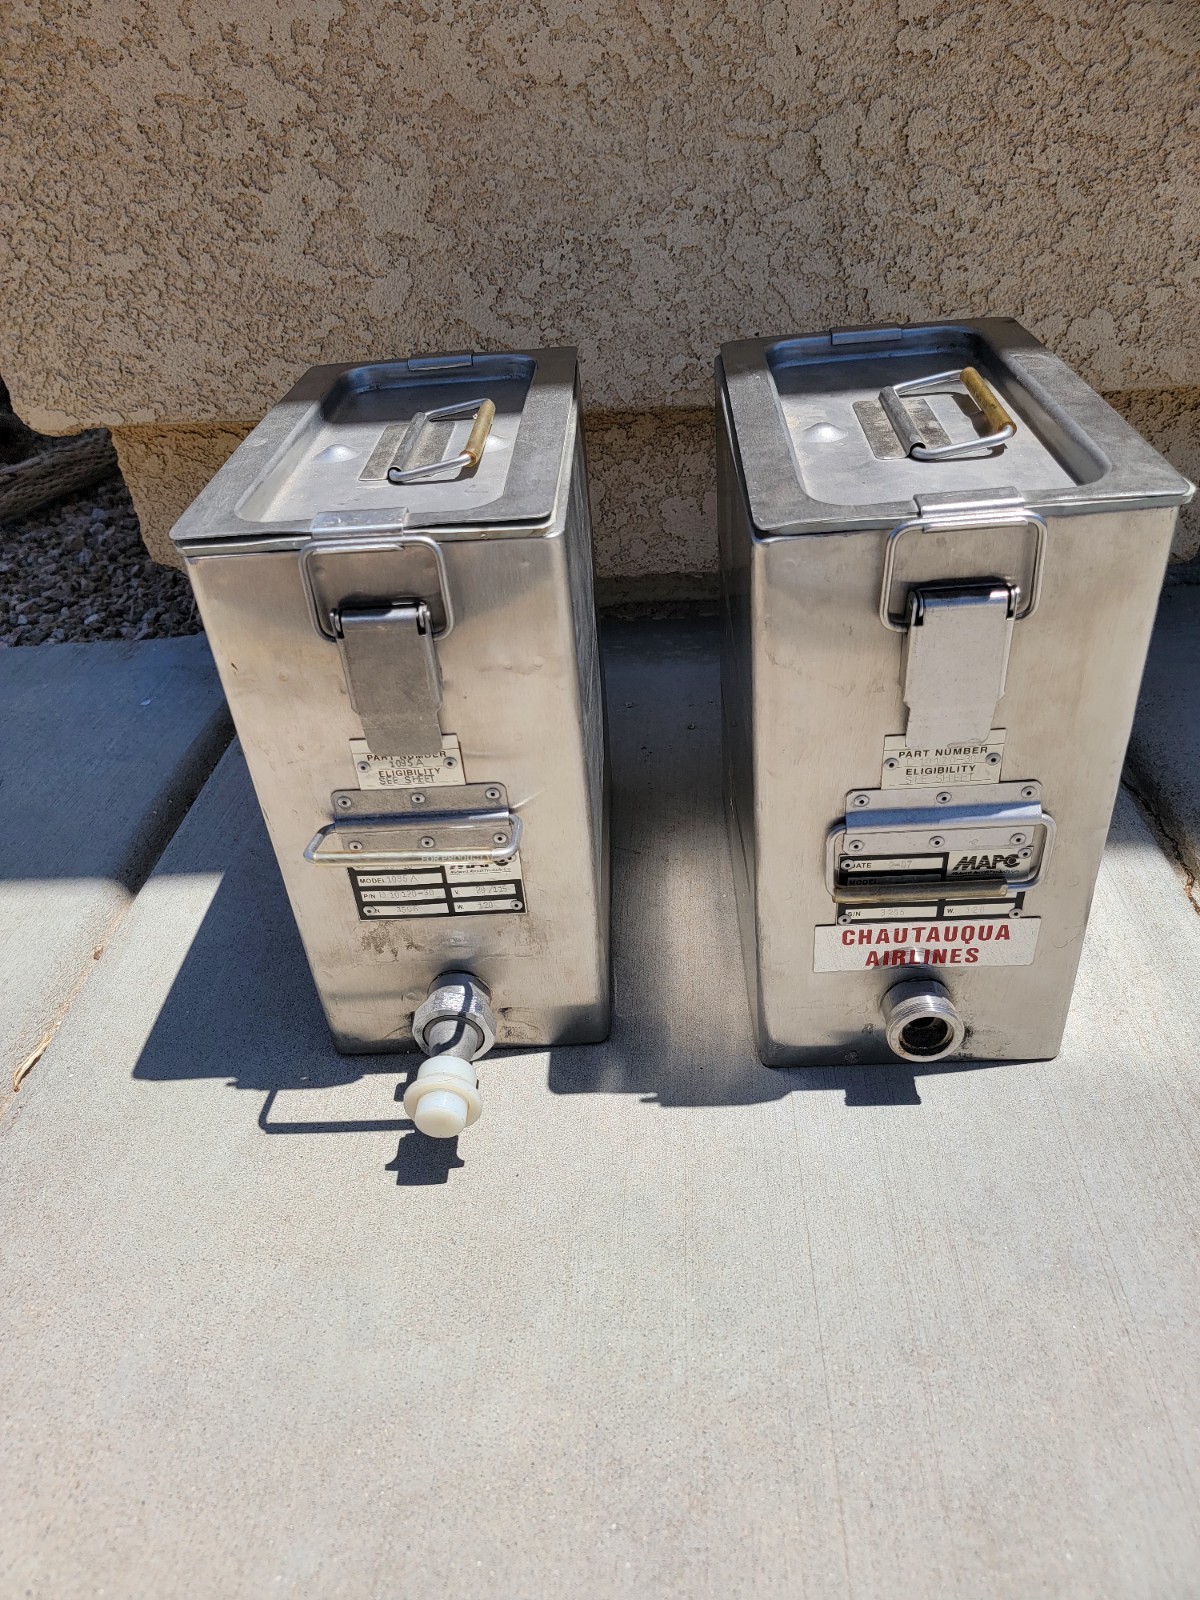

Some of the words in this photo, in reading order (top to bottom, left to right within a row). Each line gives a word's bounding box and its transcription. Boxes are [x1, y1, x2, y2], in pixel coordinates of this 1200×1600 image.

[898, 749, 930, 758] PART
[935, 746, 988, 756] NUMBER
[378, 768, 441, 778] ELIGIBILITY
[905, 765, 976, 776] ELIGIBILITY
[379, 777, 398, 785] SEE
[405, 775, 435, 784] SHEET
[841, 924, 1011, 945] CHAUTAUQUA
[865, 947, 980, 967] AIRLINES
